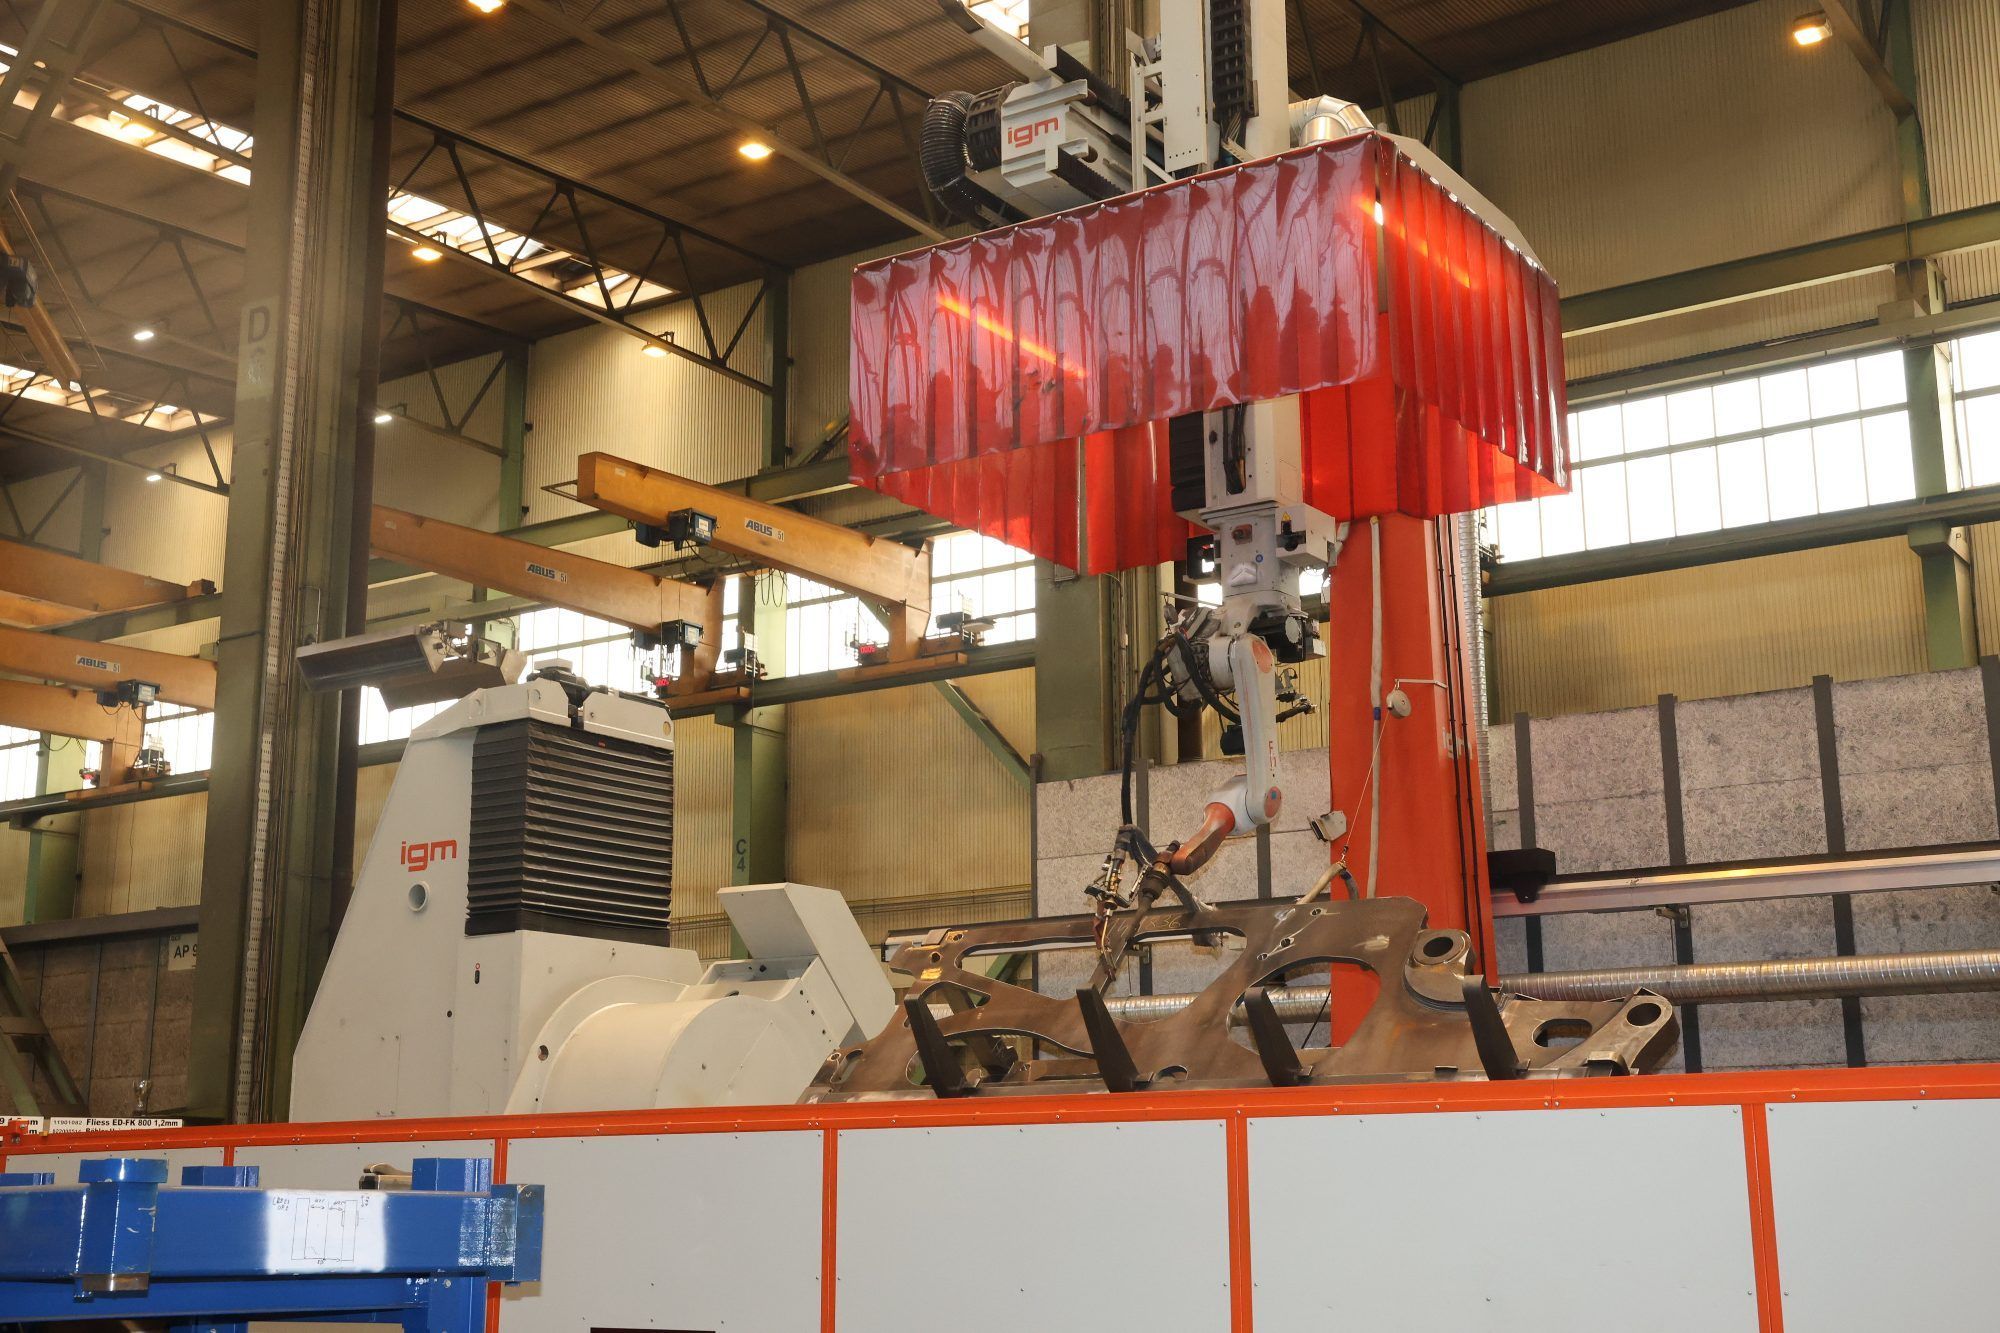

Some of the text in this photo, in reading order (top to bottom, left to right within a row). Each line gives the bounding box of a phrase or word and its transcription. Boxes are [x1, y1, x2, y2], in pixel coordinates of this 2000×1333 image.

[1008, 117, 1059, 148] igm
[248, 306, 270, 344] D
[745, 519, 773, 537] ABUS
[527, 563, 555, 580] ABUS
[77, 657, 107, 670] ABUS
[401, 840, 457, 872] igm
[173, 944, 190, 959] AP
[86, 1118, 110, 1126] Fliess
[138, 1119, 152, 1127] 800
[154, 1119, 178, 1128] 1,2mm
